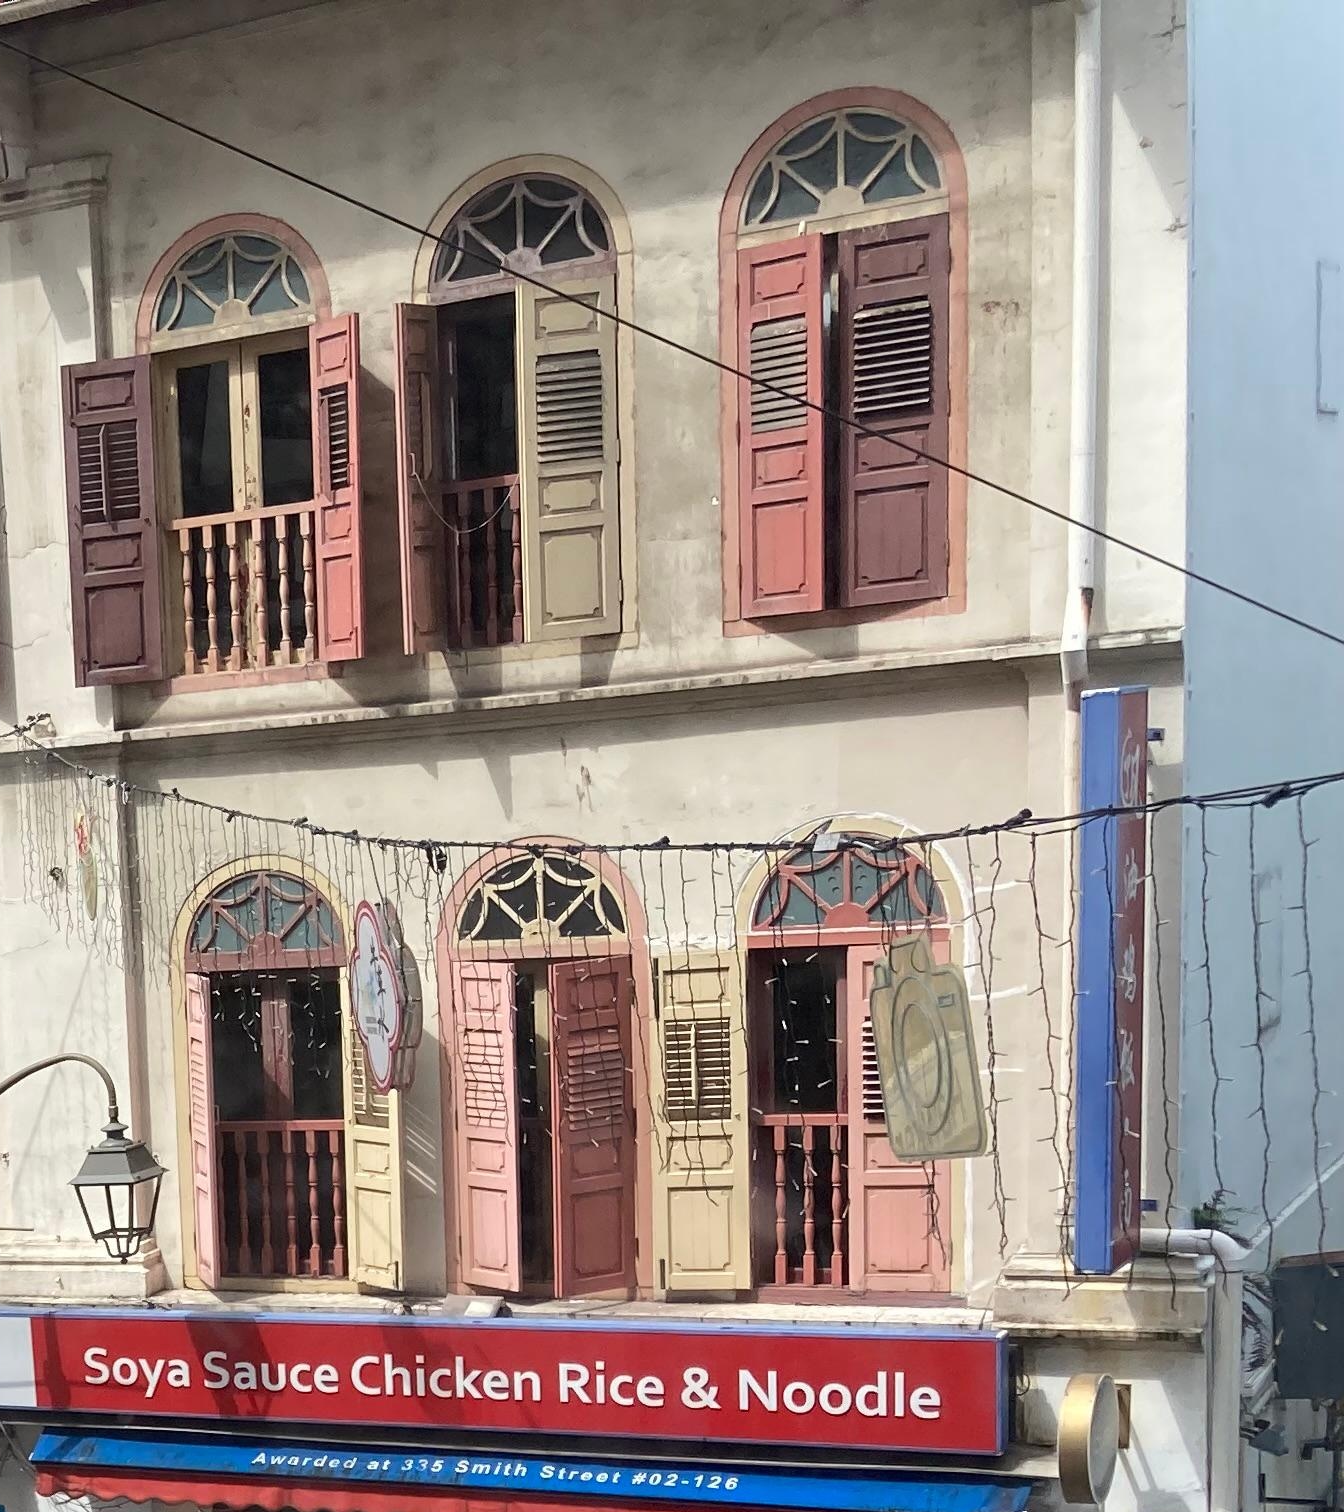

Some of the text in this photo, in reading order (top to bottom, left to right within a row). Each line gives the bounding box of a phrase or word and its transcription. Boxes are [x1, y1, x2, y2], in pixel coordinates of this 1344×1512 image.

[83, 1347, 942, 1419] Soya Sauce Chicken Rice & Noodle
[251, 1452, 740, 1492] Awarded at 335 Smith Street #02-126
